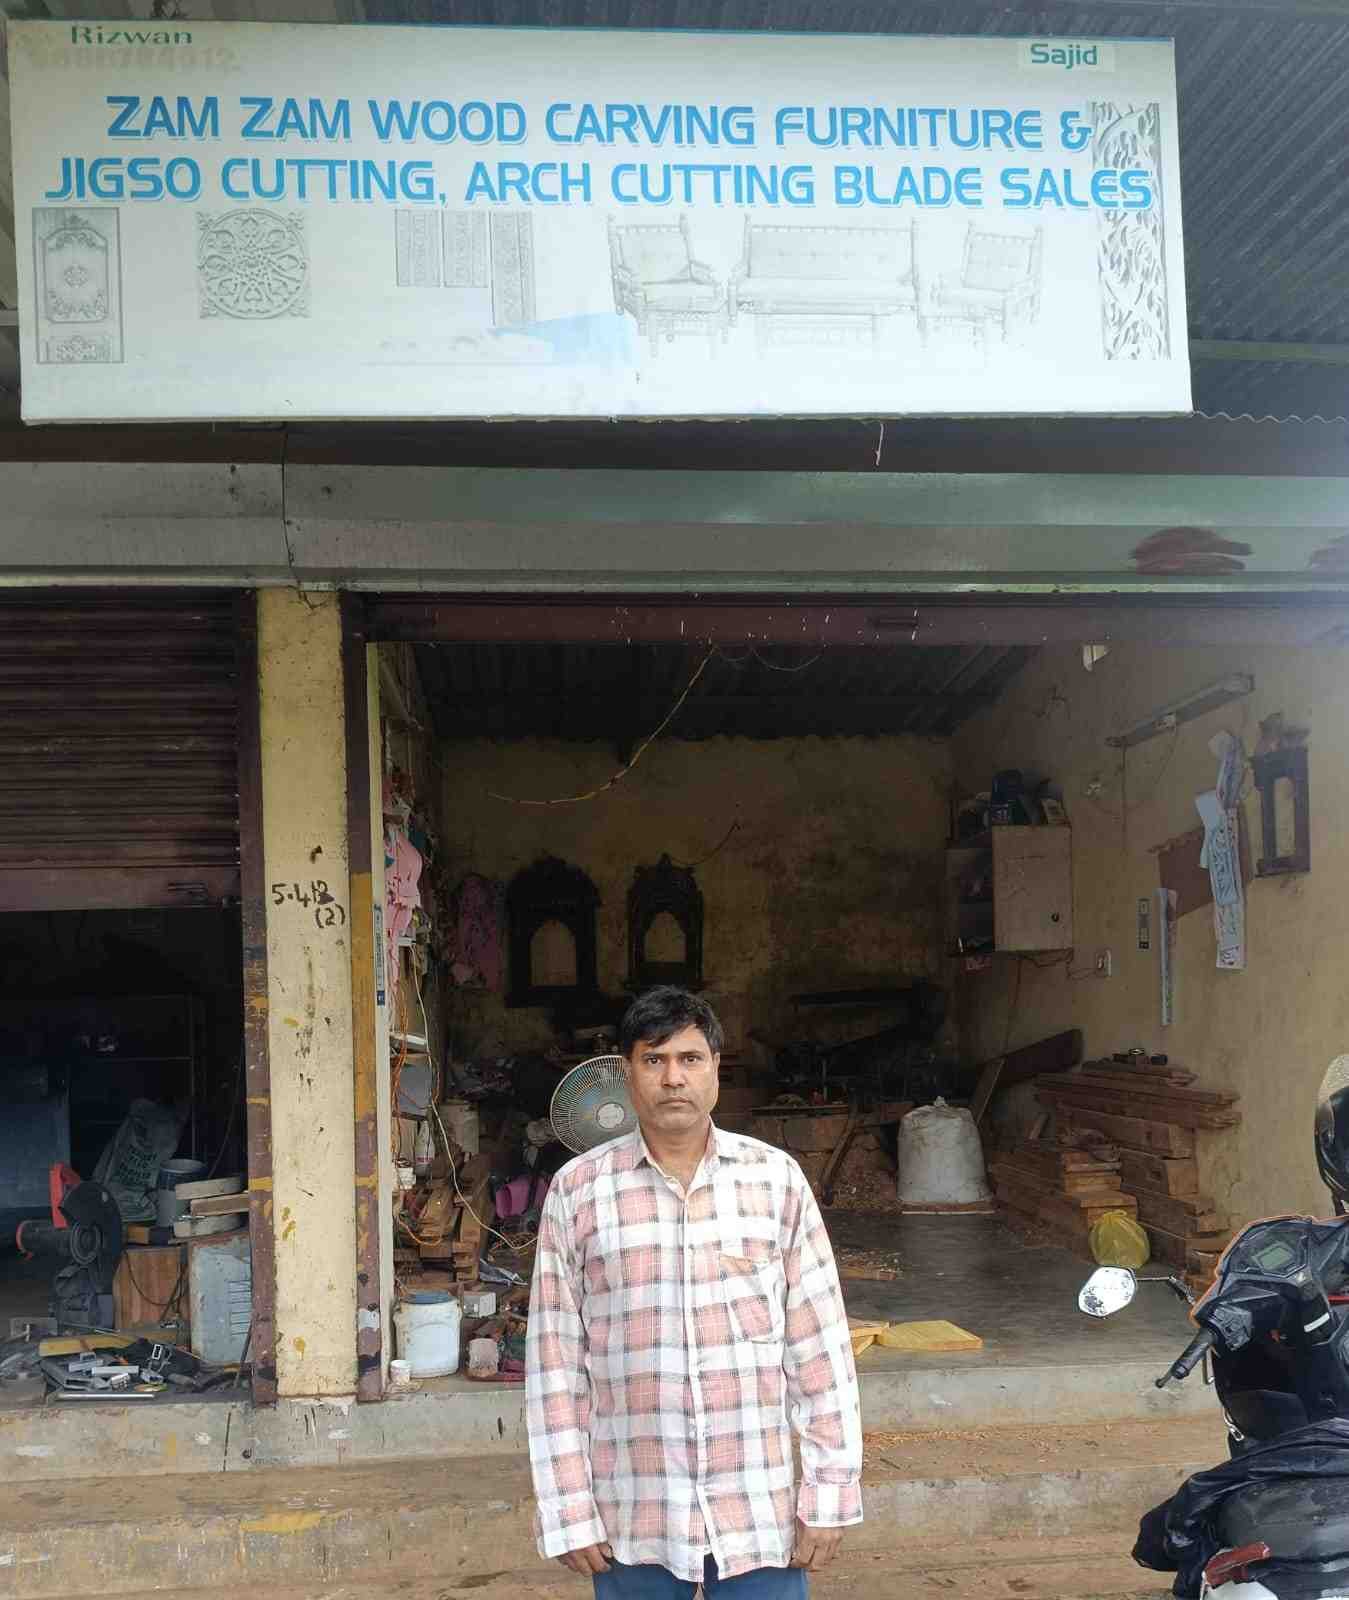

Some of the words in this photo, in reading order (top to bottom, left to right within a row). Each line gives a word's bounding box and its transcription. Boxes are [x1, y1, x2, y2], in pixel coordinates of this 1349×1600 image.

[72, 26, 193, 45] Rizwan
[1031, 43, 1097, 69] Sajid
[106, 96, 220, 139] ZAM
[240, 97, 351, 141] ZAM
[368, 99, 528, 144] WOOD
[545, 102, 757, 147] CARVING
[775, 106, 1044, 150] FURNITURE
[1060, 110, 1093, 152] &
[45, 157, 201, 200] JIGSO
[221, 158, 447, 206] CUTTING,
[464, 160, 593, 204] ARCH
[611, 163, 815, 207] CUTTING
[834, 165, 984, 208] BLADE
[1000, 167, 1153, 210] SALES
[315, 903, 346, 928] (2)
